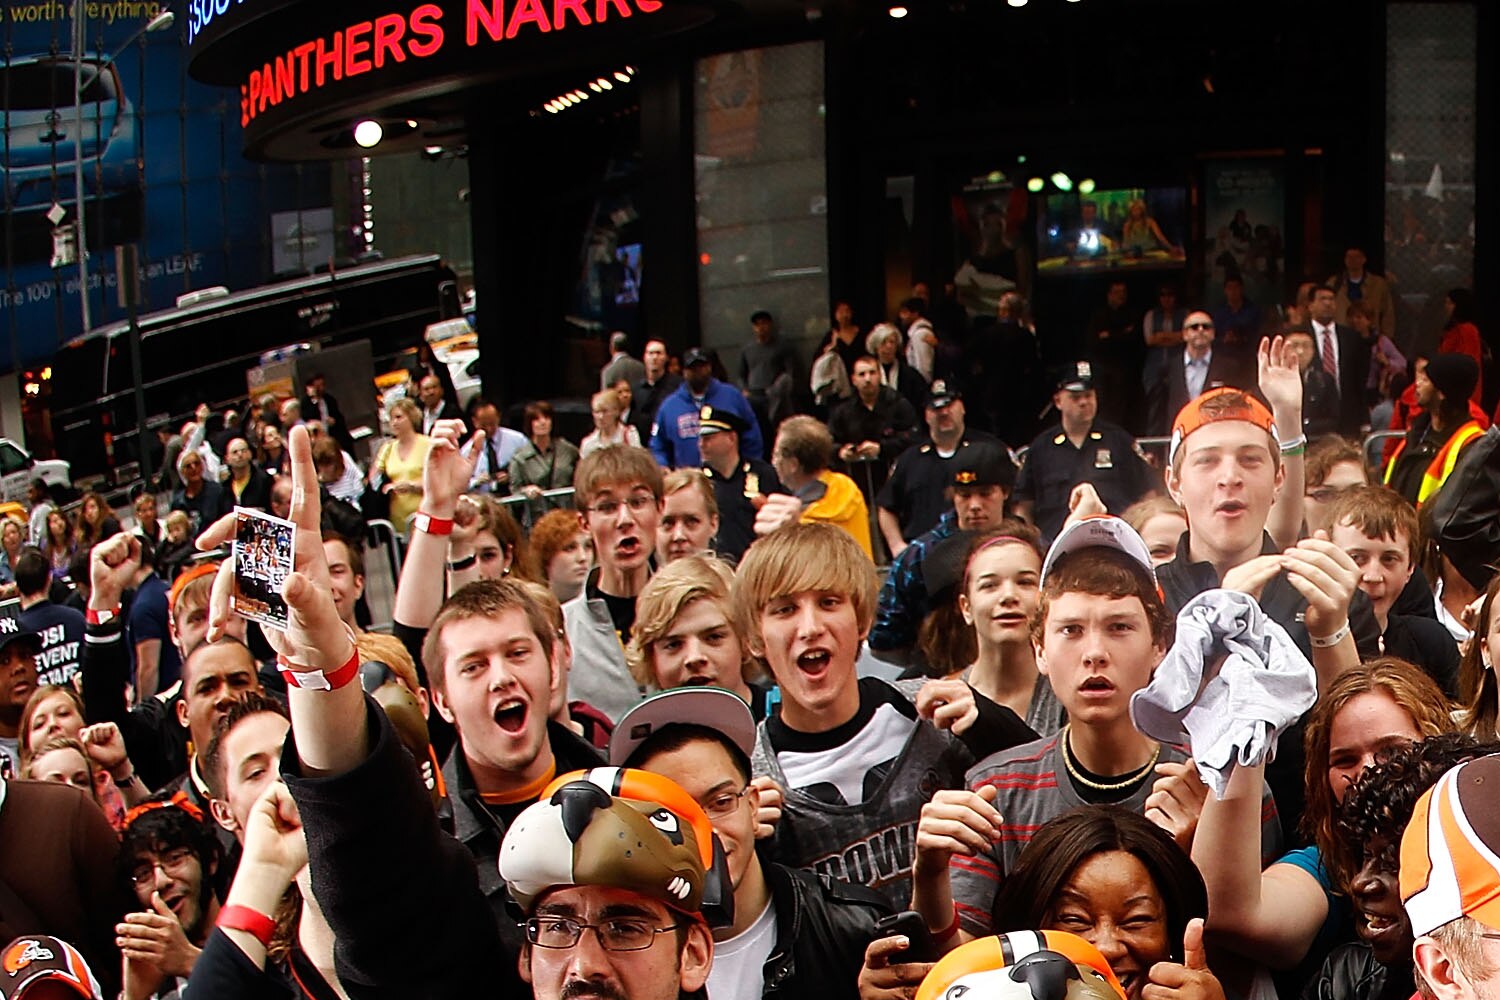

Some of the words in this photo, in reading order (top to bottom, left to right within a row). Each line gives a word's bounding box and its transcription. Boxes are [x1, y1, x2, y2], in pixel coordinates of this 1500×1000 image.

[11, 3, 64, 23] worth
[248, 4, 444, 121] PANTHERS
[33, 641, 80, 672] EVENT
